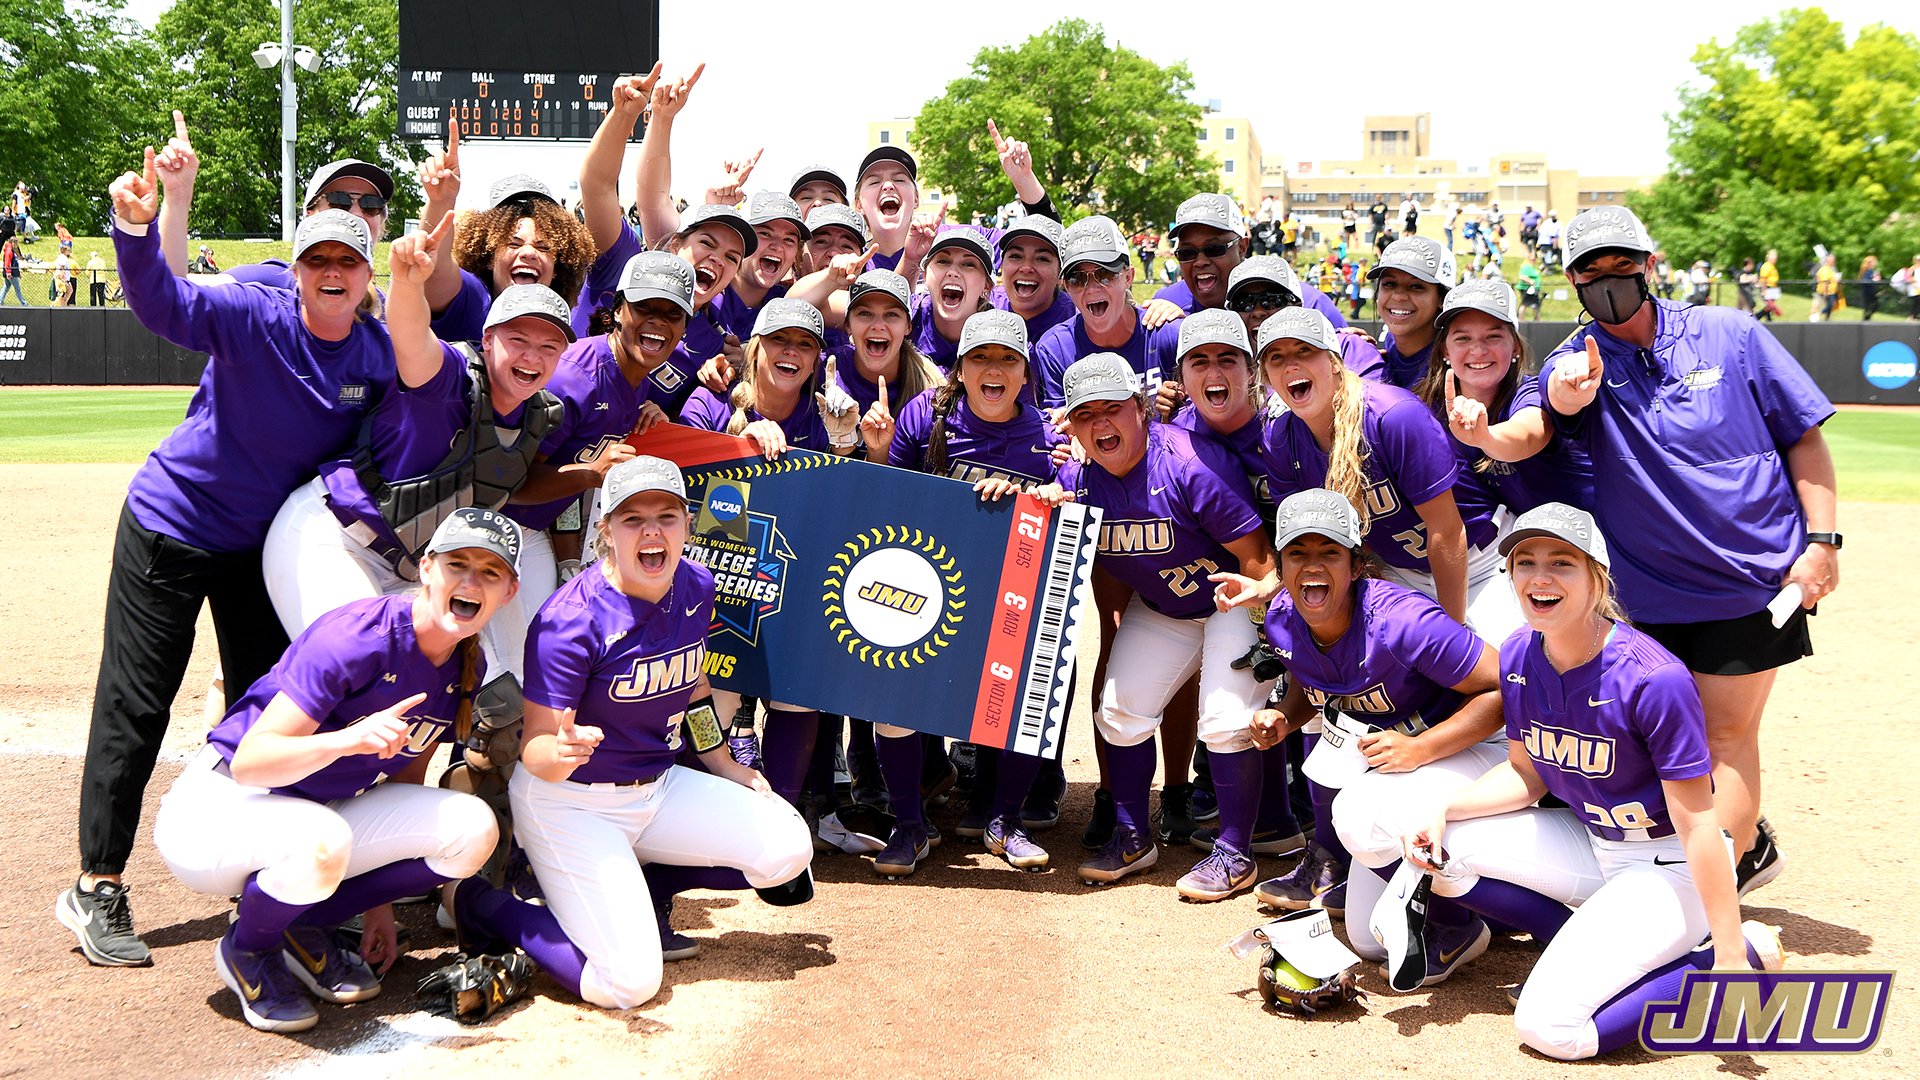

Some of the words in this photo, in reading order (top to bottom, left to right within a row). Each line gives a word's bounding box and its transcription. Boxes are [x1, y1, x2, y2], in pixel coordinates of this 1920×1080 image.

[411, 71, 424, 82] AT
[424, 71, 442, 82] BAT
[471, 72, 495, 83] BALL
[479, 82, 488, 98] 0
[523, 73, 555, 84] STRIKE
[578, 75, 597, 85] OUT
[534, 83, 543, 99] 0
[584, 84, 593, 100] 0
[406, 107, 440, 119] GUEST
[570, 101, 580, 110] 10
[588, 101, 608, 111] RUNS
[410, 123, 437, 134] HOME
[326, 210, 367, 246] BOUND
[1060, 234, 1071, 257] OKC
[1074, 221, 1112, 246] BOUND
[1568, 220, 1586, 249] OKC
[1589, 210, 1636, 238] BOUND
[633, 259, 657, 280] OKC
[662, 256, 692, 295] BOUND
[0, 325, 27, 336] 2018
[767, 300, 789, 322] OKC
[794, 299, 821, 335] BOUND
[965, 316, 984, 340] OKC
[990, 312, 1024, 343] BOUND
[1183, 318, 1201, 343] OKC
[1205, 312, 1243, 342] BOUND
[1279, 307, 1321, 335] BOUND
[0, 337, 27, 348] 2019
[0, 350, 27, 361] 2021
[1066, 370, 1079, 396] OKC
[1082, 360, 1123, 385] BOUND
[609, 465, 629, 494] OKC
[635, 457, 680, 490] BOUND
[710, 499, 742, 515] NCAA
[1280, 501, 1300, 528] OKC
[1305, 493, 1349, 528] BOUND
[1544, 501, 1588, 540] BOUND
[482, 511, 518, 556] BOUND
[1017, 511, 1044, 542] 21
[1098, 521, 1171, 551] JMU
[1392, 521, 1428, 559] 2
[682, 543, 756, 577] COLLEGE
[710, 538, 757, 555] WOMEN'S
[1015, 539, 1035, 569] SEAT
[714, 573, 780, 603] SERIES
[723, 596, 748, 608] CITY
[858, 581, 928, 615] JMU
[1003, 590, 1028, 612] 3
[1002, 609, 1020, 638] ROW
[1274, 646, 1293, 660] CAA
[383, 672, 398, 685] AA
[614, 644, 704, 698] JMU
[989, 660, 1015, 682] 6
[1506, 672, 1527, 687] CAA
[984, 680, 1007, 729] SECTION
[1525, 725, 1612, 775] JMU
[1309, 919, 1331, 939] JM
